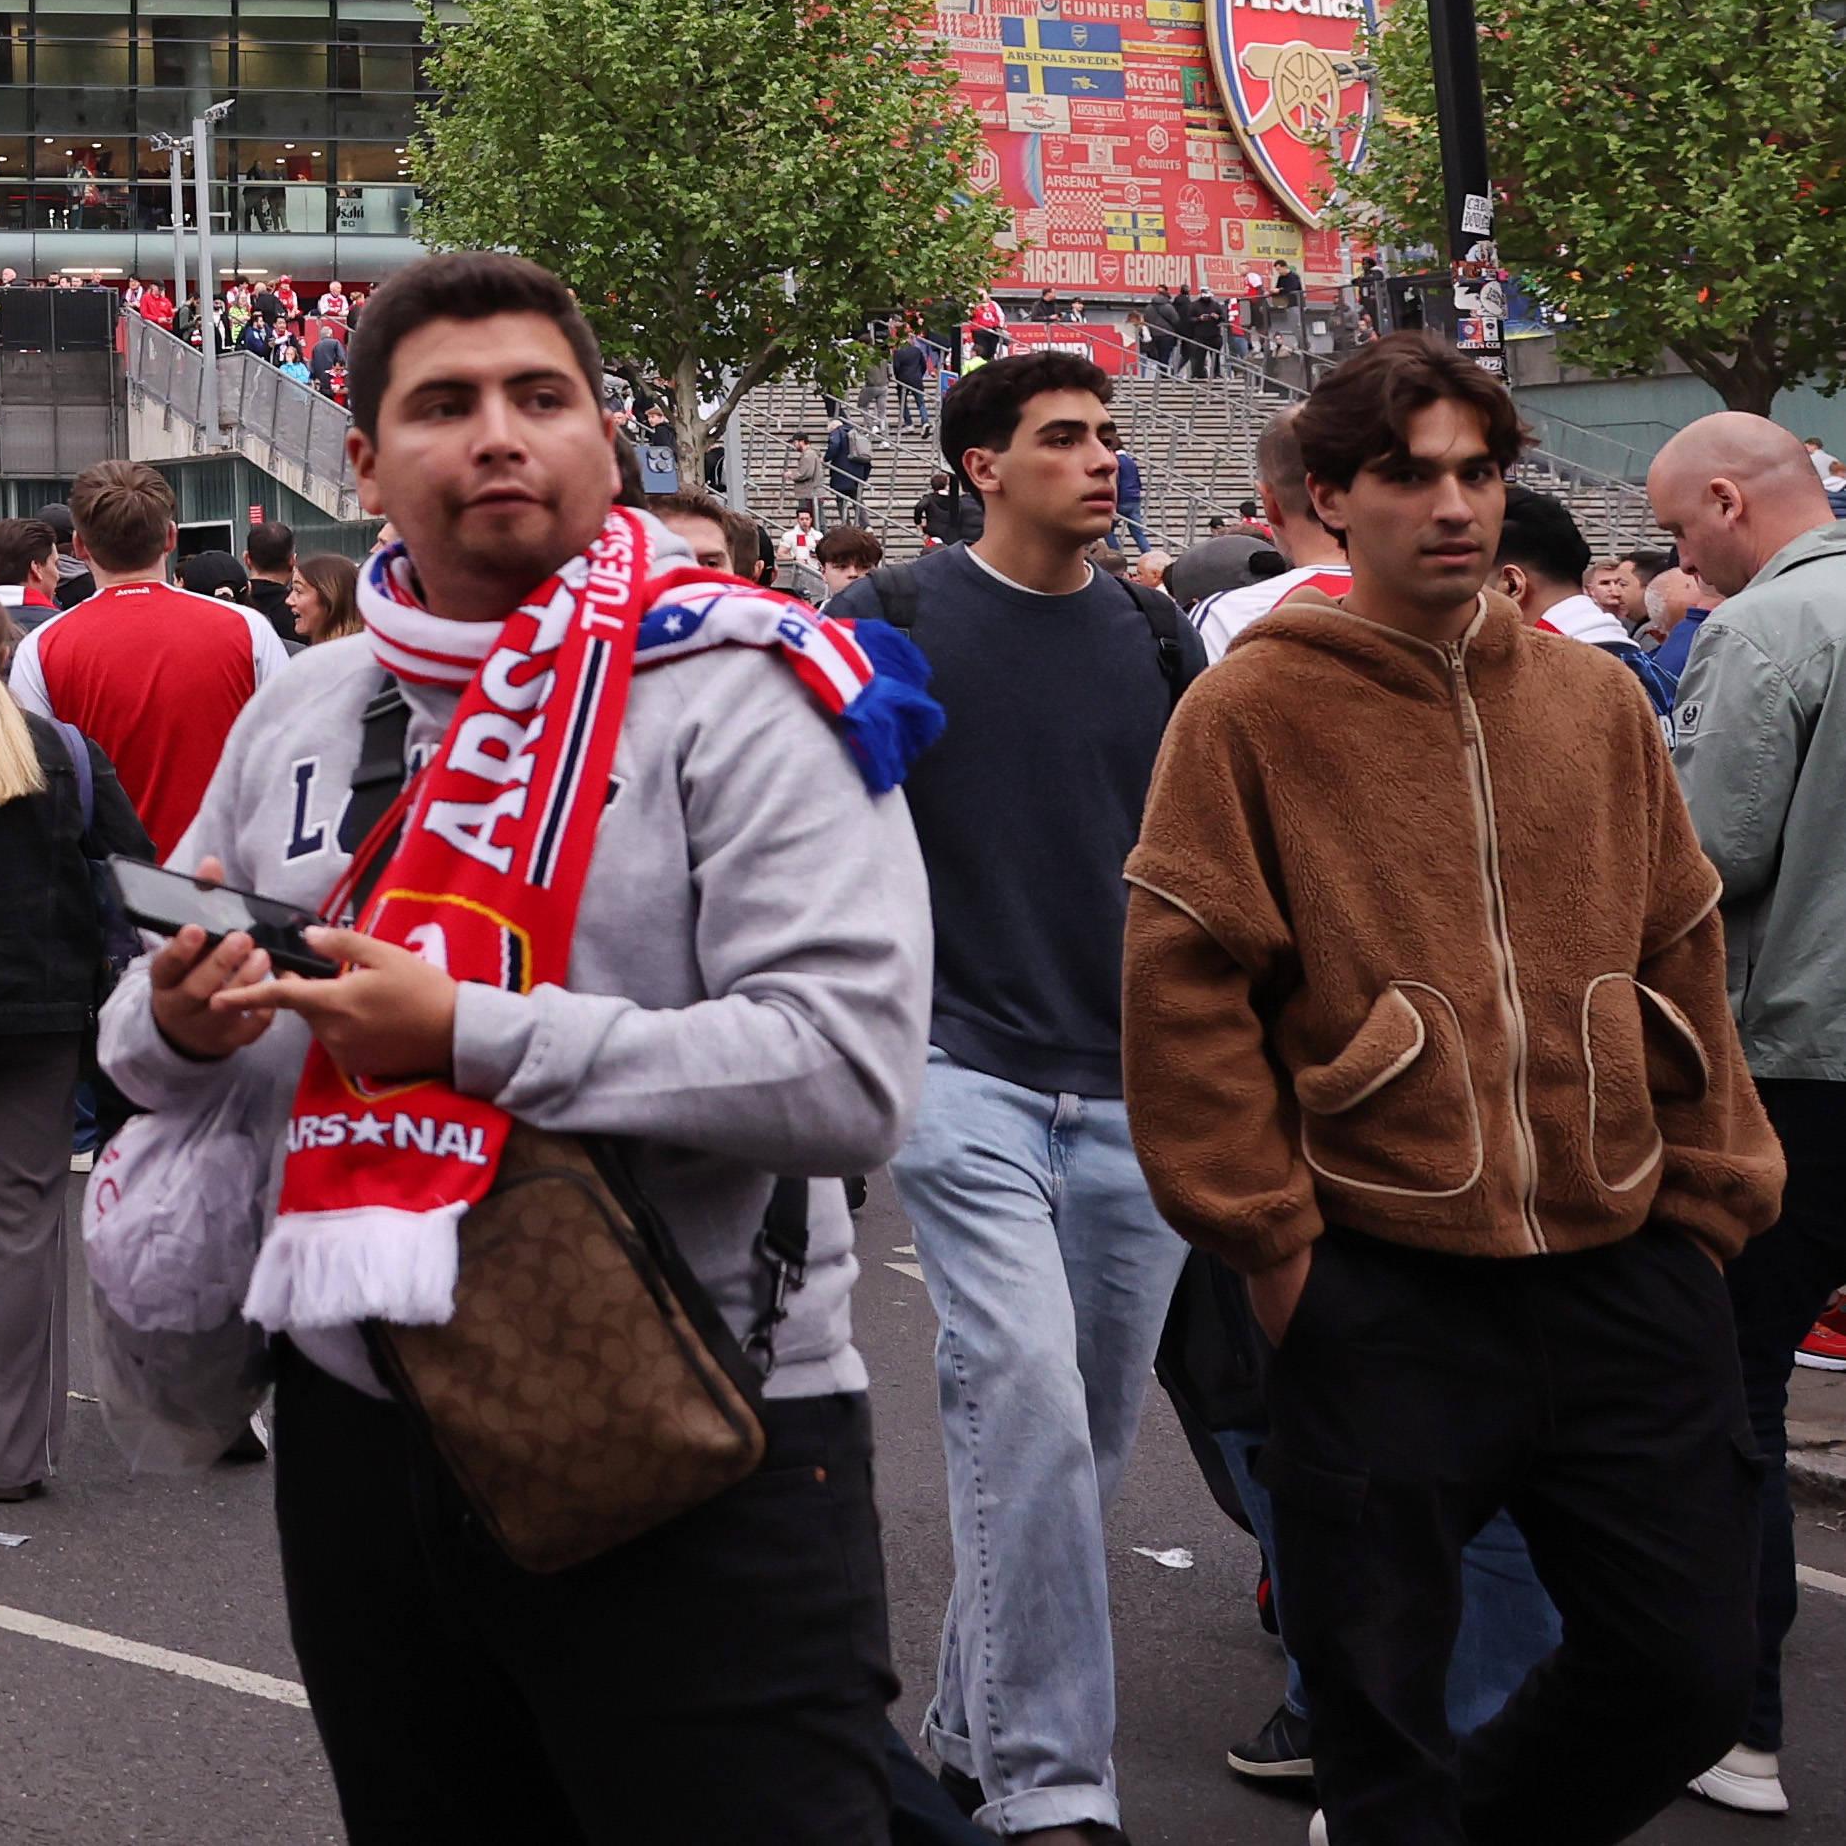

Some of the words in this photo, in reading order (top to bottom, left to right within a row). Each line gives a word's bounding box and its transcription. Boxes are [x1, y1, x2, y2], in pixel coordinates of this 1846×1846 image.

[1061, 0, 1145, 20] GUNNERS
[1006, 51, 1066, 64] ARSENAL
[1068, 54, 1120, 66] SWEDEN
[1124, 70, 1180, 92] Kerala
[1131, 104, 1181, 123] Islington
[1045, 175, 1101, 189] ARSENAL
[1052, 232, 1103, 246] CROATIA
[1022, 249, 1100, 285] ARSENAL
[1123, 252, 1192, 289] GEORGIA
